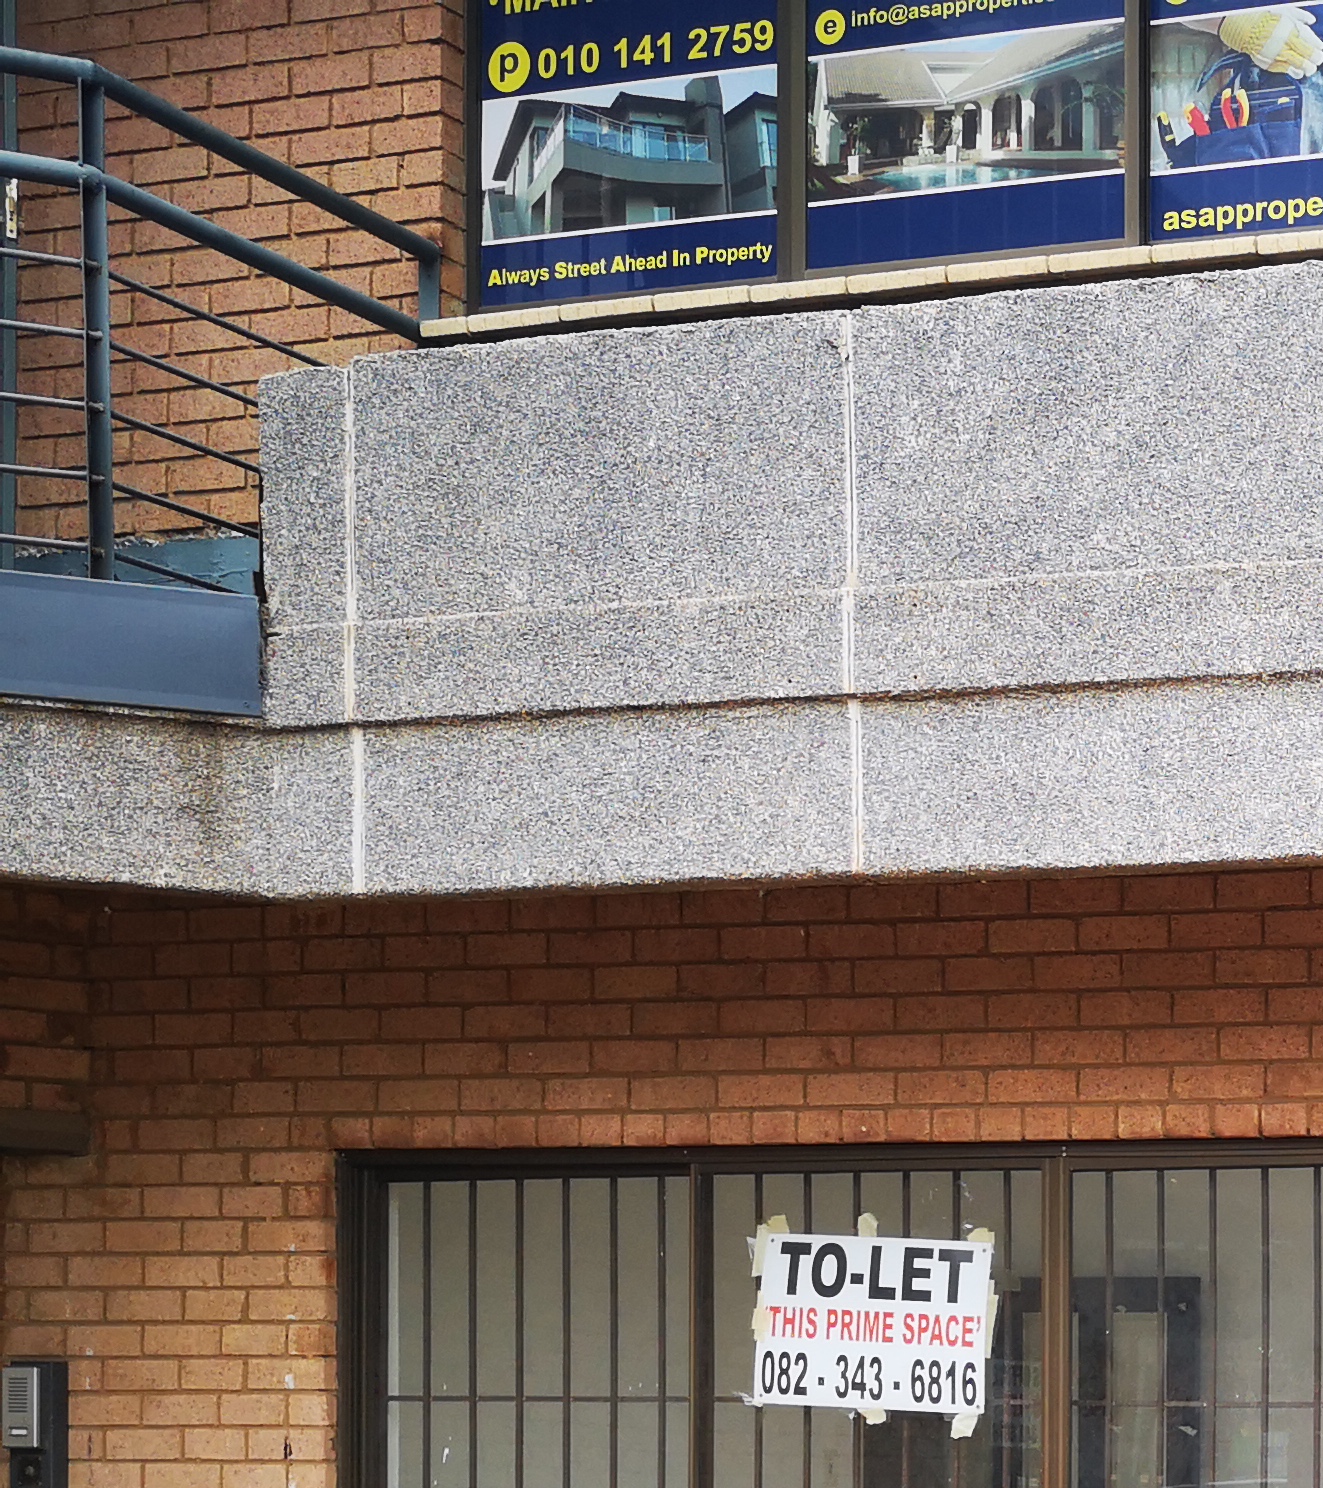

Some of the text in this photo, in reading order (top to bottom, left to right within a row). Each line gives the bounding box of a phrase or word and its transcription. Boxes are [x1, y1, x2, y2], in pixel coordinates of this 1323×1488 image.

[537, 43, 600, 79] 010
[613, 32, 671, 69] 141
[687, 19, 774, 60] 2759
[487, 243, 773, 288] Always Street Ahead In Property
[780, 1241, 974, 1304] TO-LET
[825, 1308, 895, 1344] PRIME
[761, 1350, 808, 1396] 082
[834, 1354, 883, 1401] 343
[911, 1358, 977, 1406] 6816
